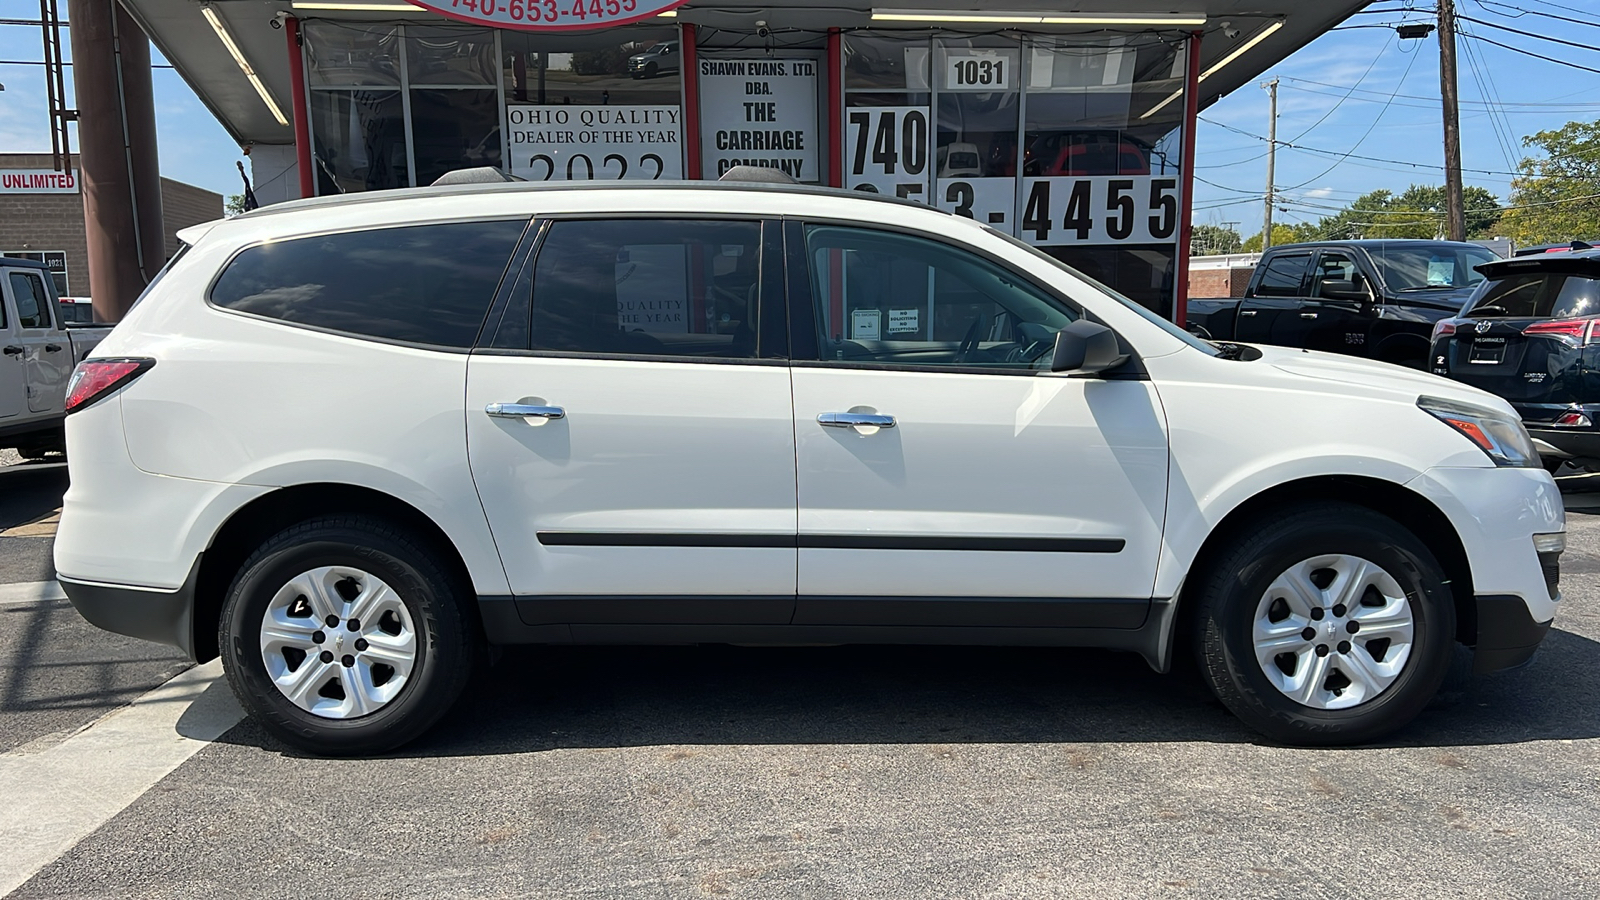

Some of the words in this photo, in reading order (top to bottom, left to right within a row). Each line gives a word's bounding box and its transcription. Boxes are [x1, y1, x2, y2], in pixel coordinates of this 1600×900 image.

[701, 62, 745, 76] SHAWN
[793, 63, 816, 77] LTD.
[953, 59, 1004, 86] 1031
[745, 82, 773, 95] DBA.
[510, 110, 569, 124] OHIO
[580, 110, 679, 127] QUALITY
[743, 102, 777, 122] THE
[513, 131, 575, 144] DEALER
[579, 131, 599, 144] OF
[602, 131, 634, 144] THE
[637, 131, 677, 144] YEAR
[716, 130, 804, 151] CARRIAGE
[849, 110, 928, 176] 740
[529, 153, 664, 181] 2022
[2, 174, 75, 189] UNLIMITED
[620, 314, 640, 323] HE
[646, 313, 682, 323] YEAR
